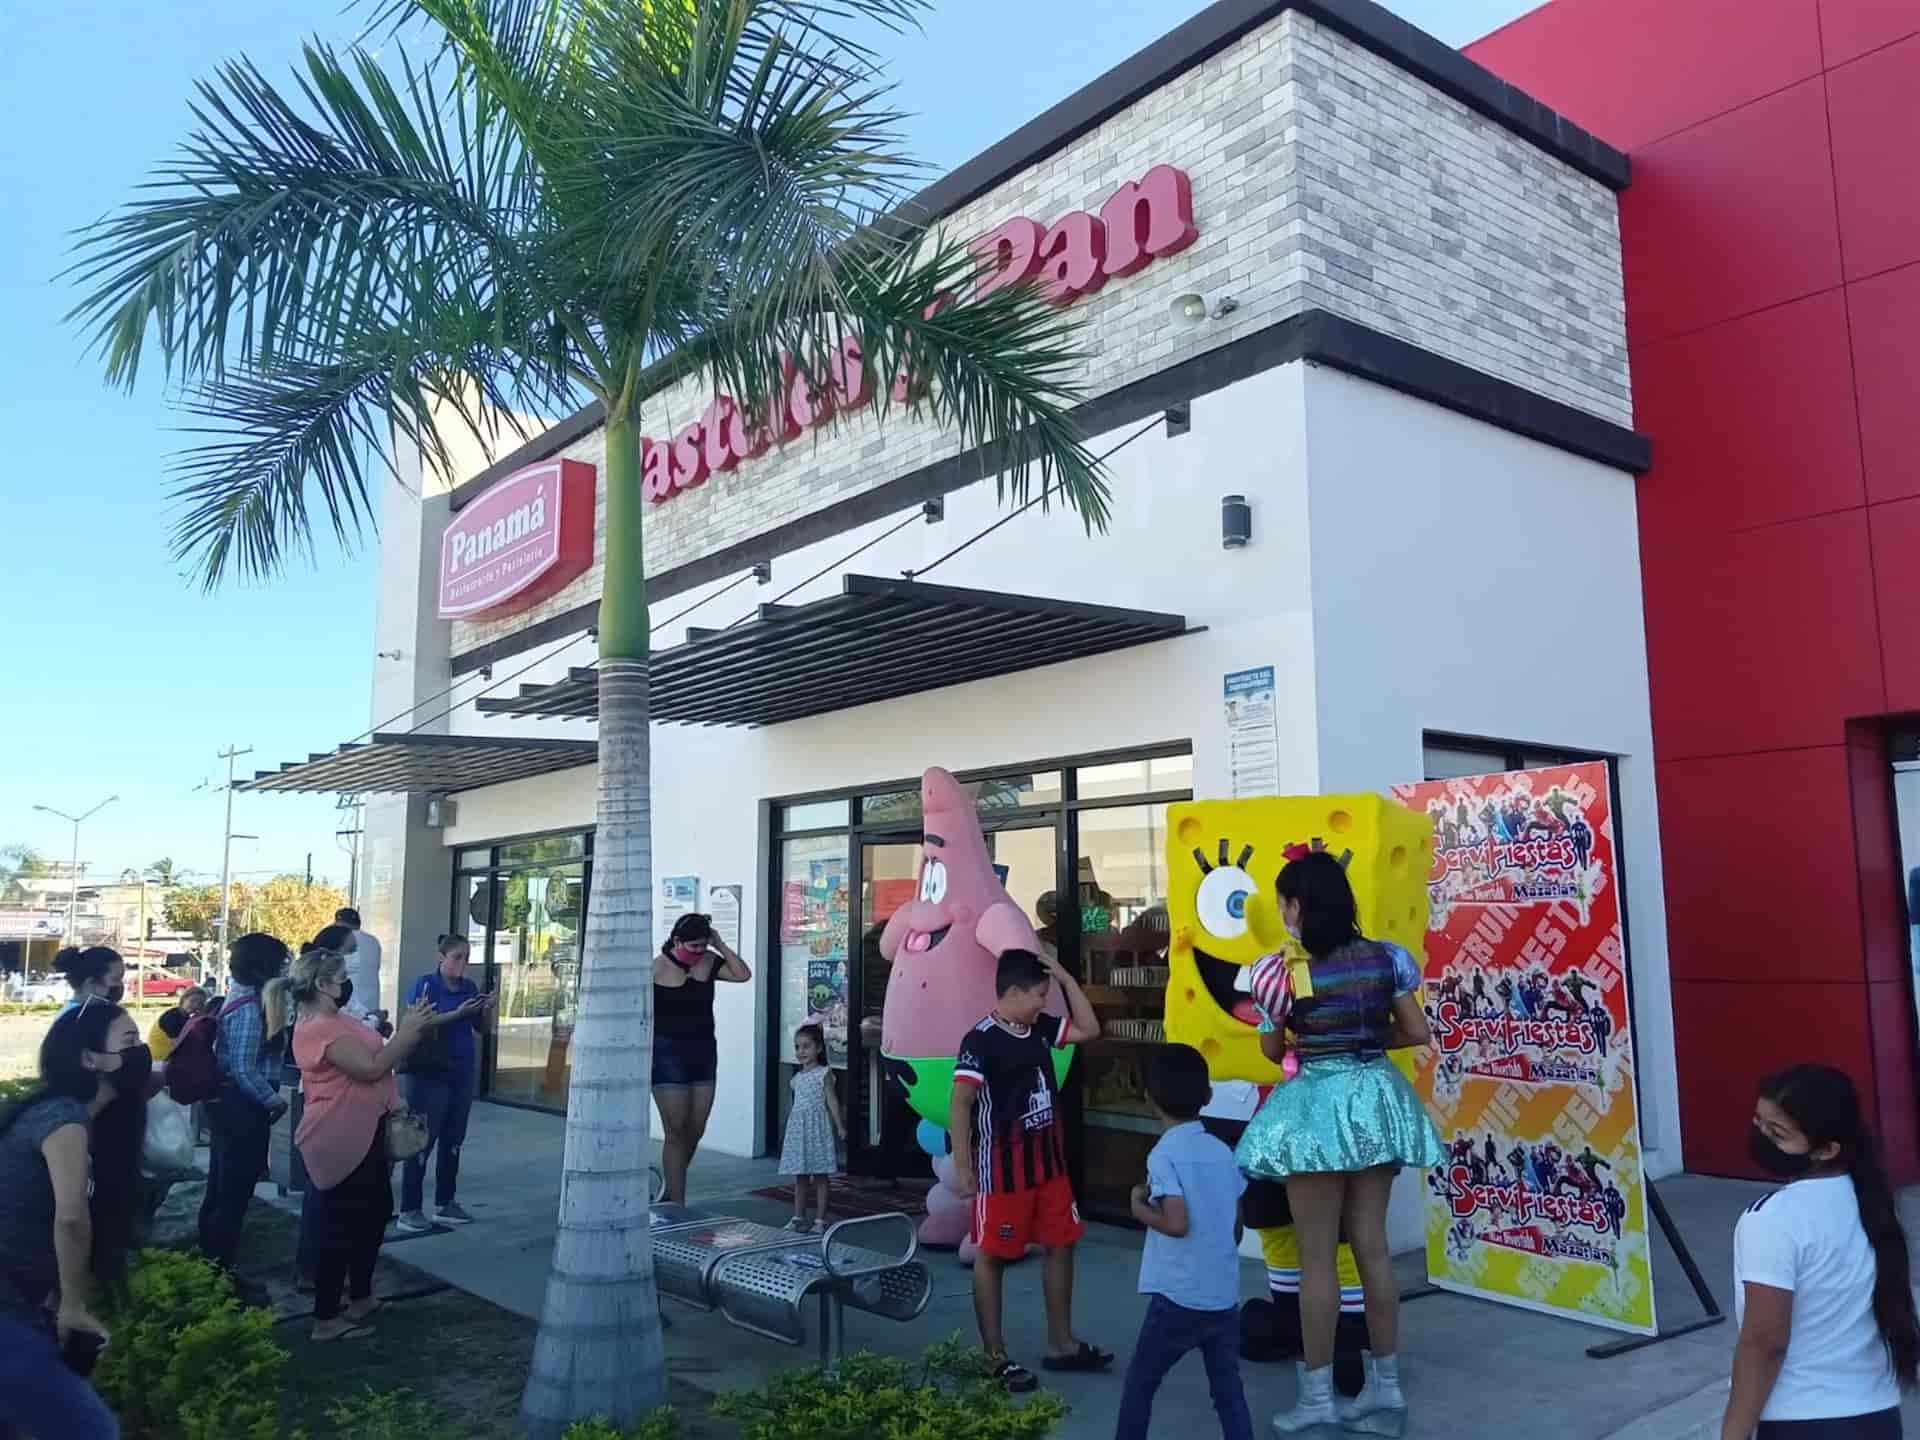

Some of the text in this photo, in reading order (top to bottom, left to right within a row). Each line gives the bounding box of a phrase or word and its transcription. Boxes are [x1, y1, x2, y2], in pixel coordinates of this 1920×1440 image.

[641, 338, 872, 503] asteles
[967, 163, 1200, 306] Pan
[450, 485, 547, 573] Panamá
